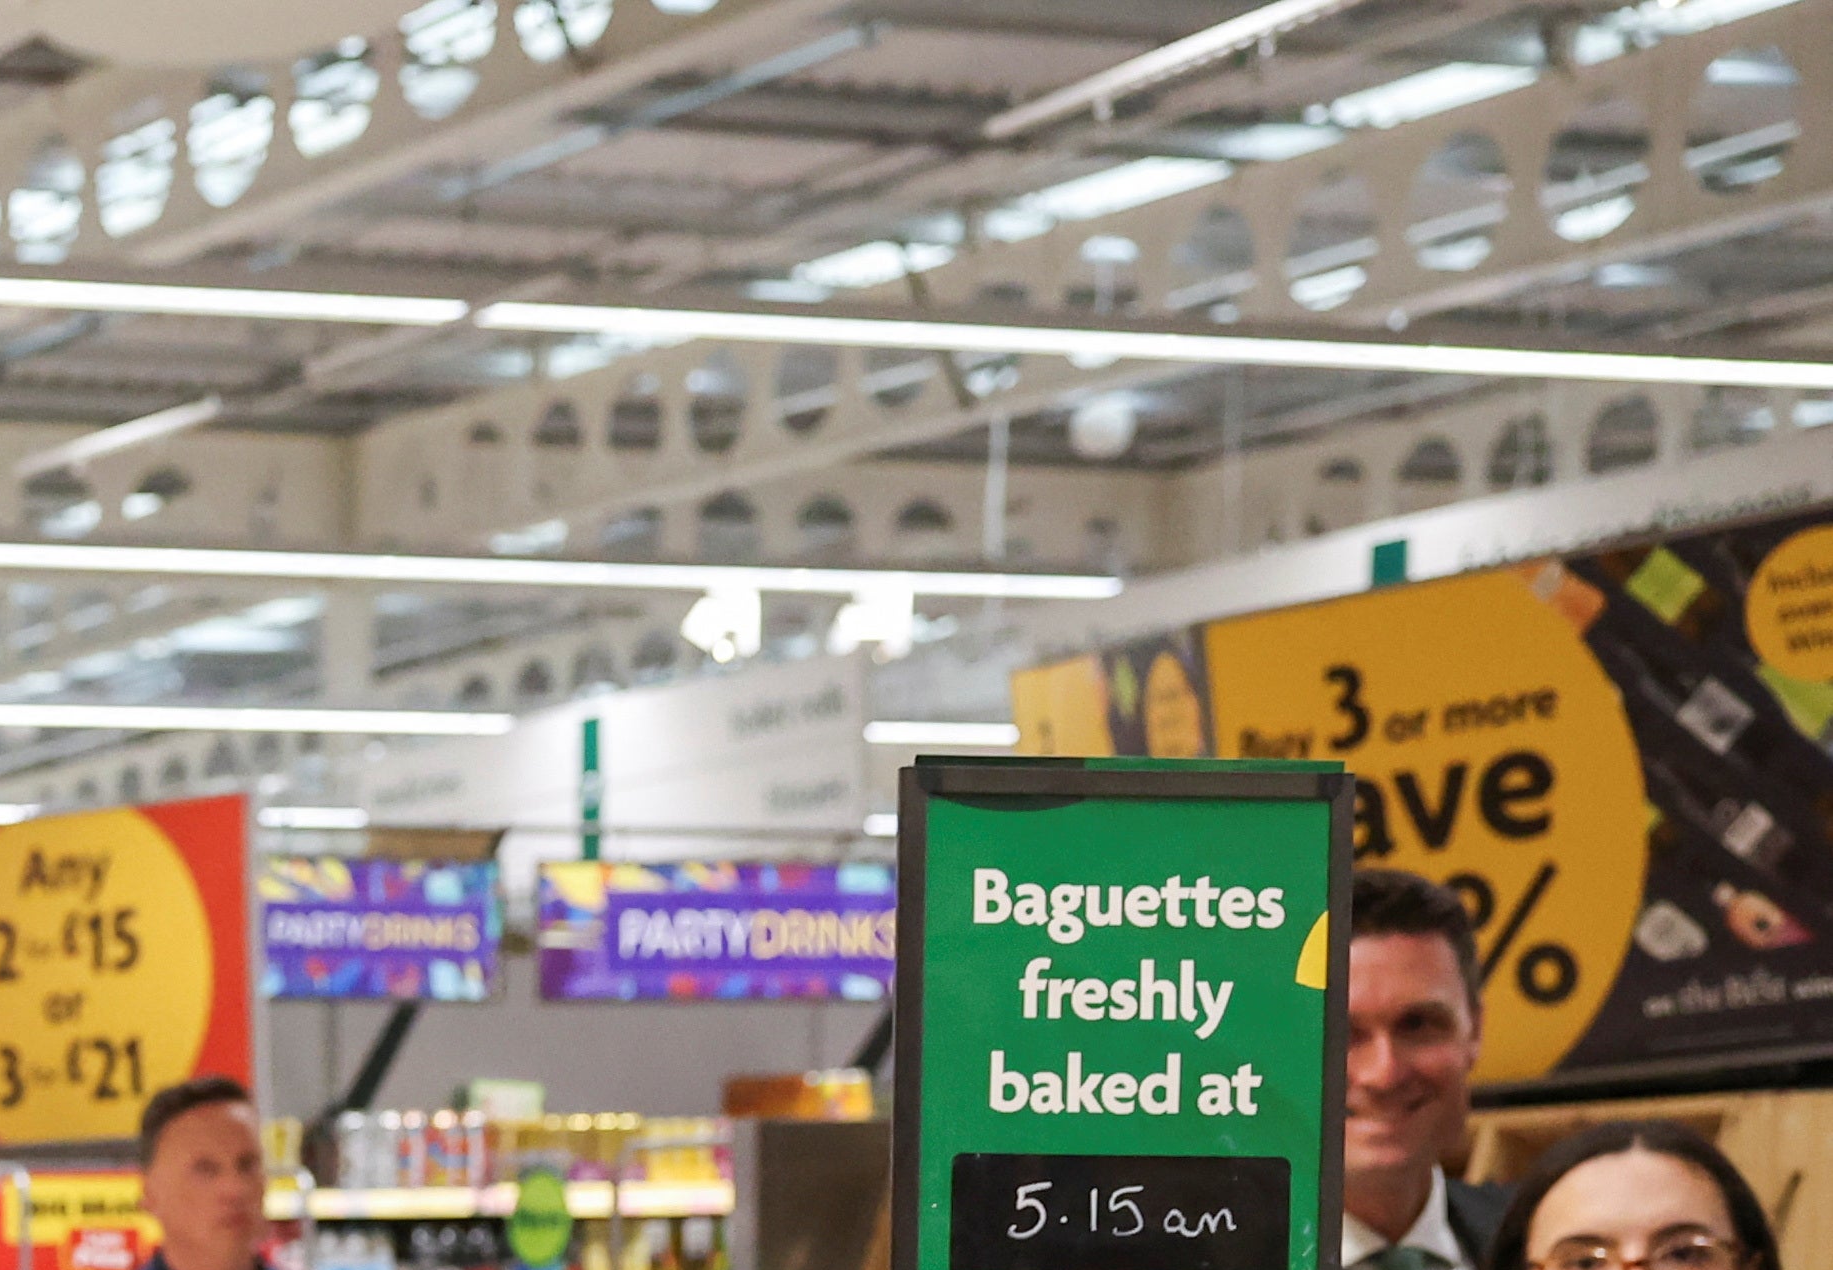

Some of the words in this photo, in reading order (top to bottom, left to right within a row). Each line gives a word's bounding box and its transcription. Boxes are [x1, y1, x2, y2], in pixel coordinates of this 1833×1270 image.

[1326, 664, 1369, 751] 3
[1384, 708, 1429, 742] or
[1441, 688, 1559, 735] more
[1355, 750, 1557, 858] ave
[17, 850, 113, 902] Any
[973, 868, 1286, 945] Baguettes
[617, 907, 897, 961] PARTYDRINKS
[1018, 957, 1235, 1040] freshly
[989, 1050, 1182, 1116] baked
[1196, 1063, 1263, 1117] at
[1007, 1180, 1145, 1240] 5.15
